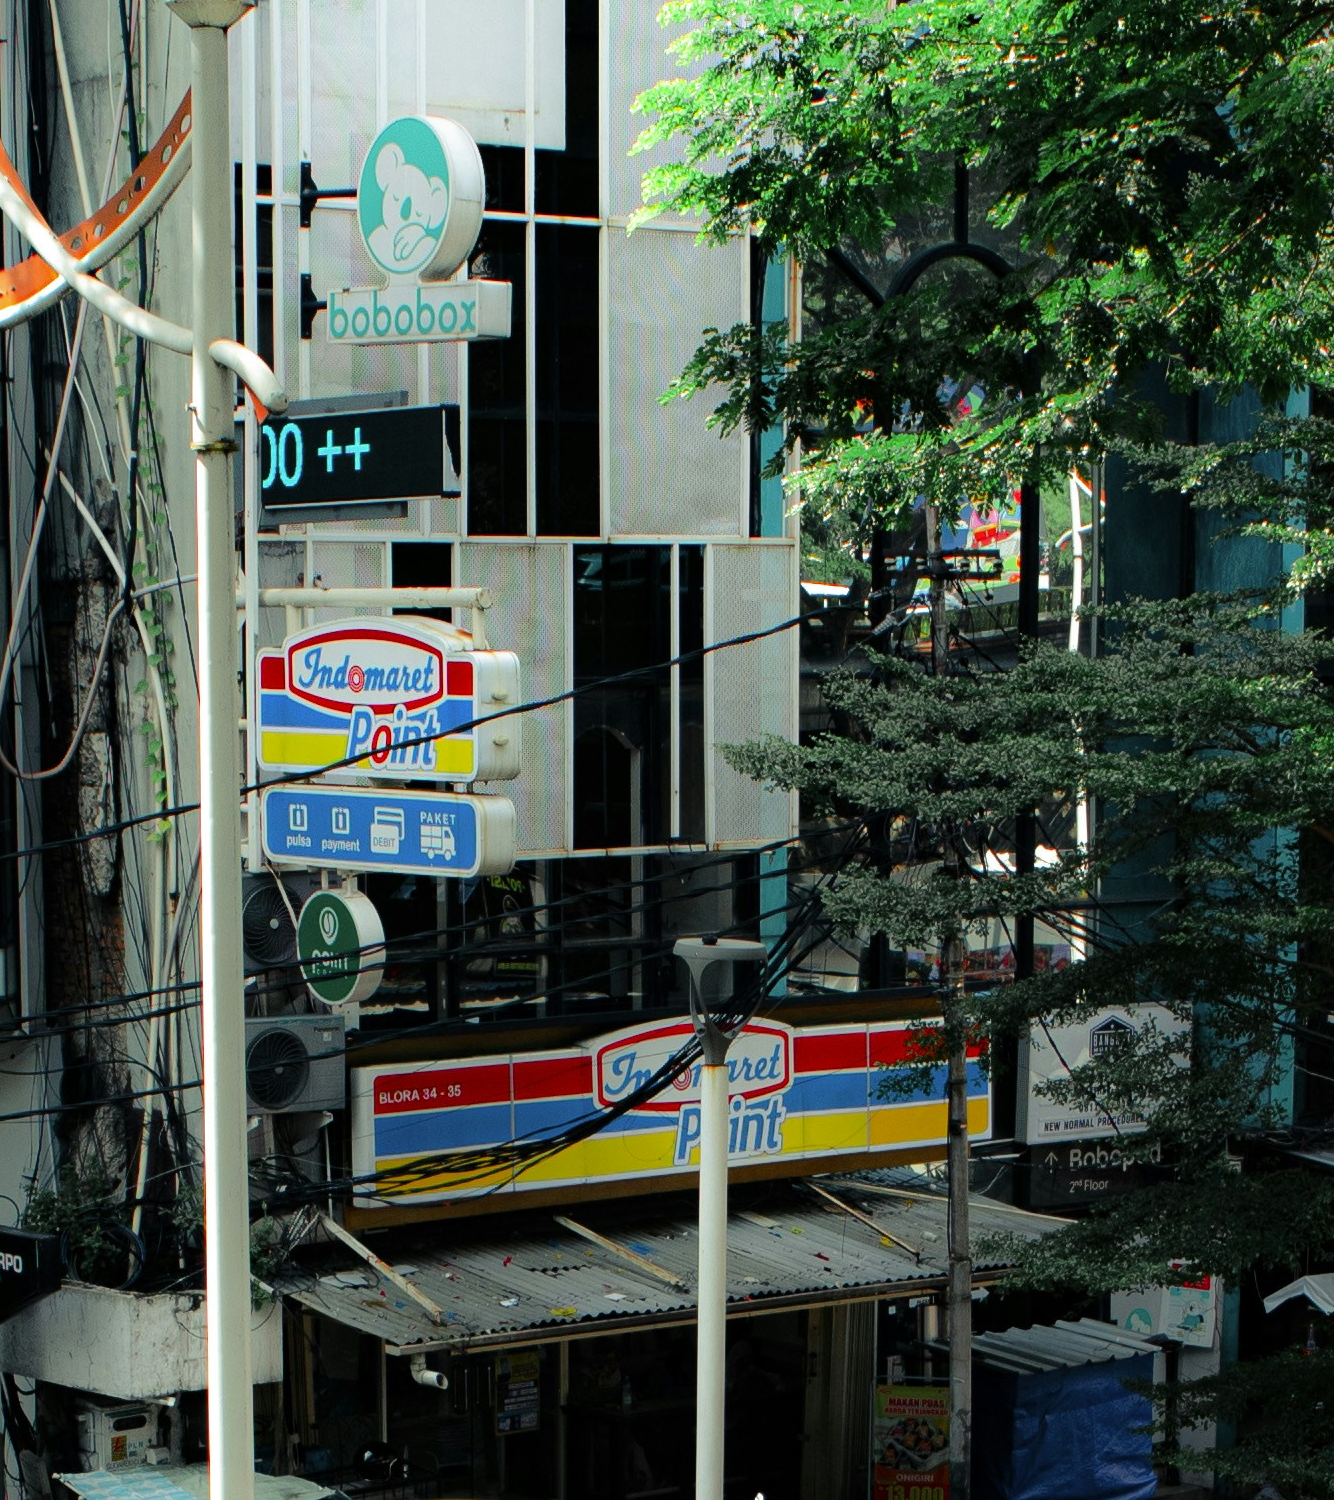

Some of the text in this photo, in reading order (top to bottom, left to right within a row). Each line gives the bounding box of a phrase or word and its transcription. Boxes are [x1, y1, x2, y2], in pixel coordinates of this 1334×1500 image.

[330, 287, 476, 339] bobobox
[298, 646, 434, 694] Indomaret
[347, 705, 442, 766] Point
[420, 811, 456, 825] PAKET
[286, 834, 311, 849] pulsa
[321, 839, 361, 853] payment
[373, 836, 396, 848] DEBIT
[379, 1089, 420, 1105] BLORA
[422, 1087, 437, 1100] 34
[447, 1084, 461, 1098] 35
[677, 1097, 781, 1161] Pint
[1044, 1119, 1060, 1132] NEW
[1063, 1117, 1094, 1130] NORMAL
[1084, 1179, 1110, 1191] Floor
[888, 1397, 919, 1408] MAKAN
[896, 1473, 934, 1482] ONIGIRI
